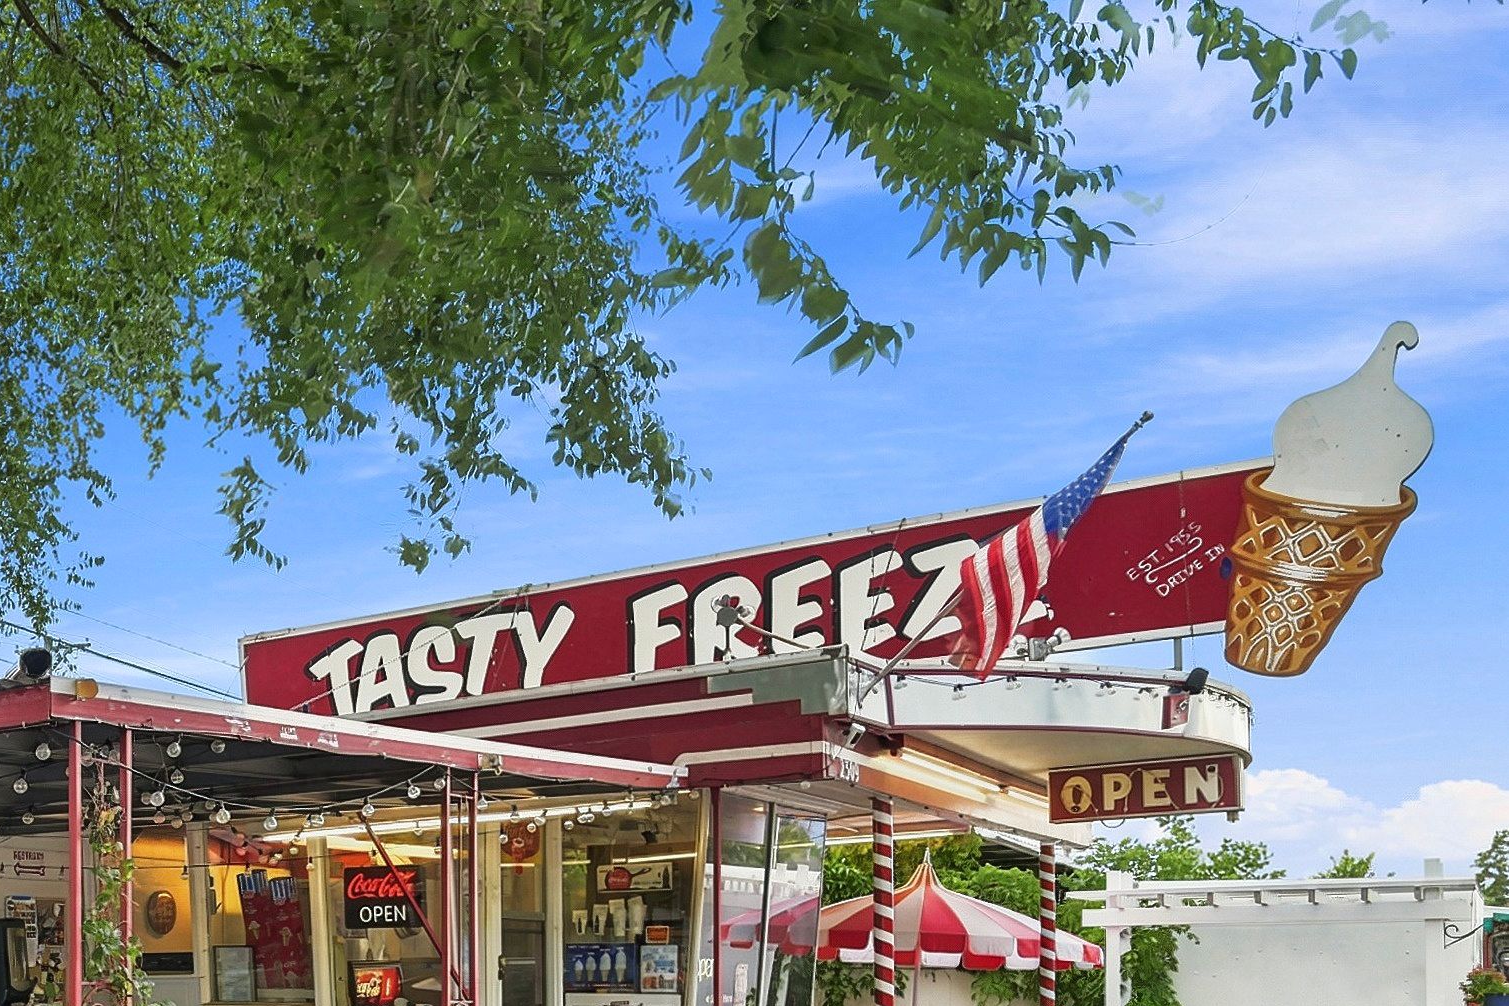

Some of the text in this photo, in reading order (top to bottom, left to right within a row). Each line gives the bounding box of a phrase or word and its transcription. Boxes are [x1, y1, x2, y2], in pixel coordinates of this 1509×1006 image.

[1126, 521, 1202, 581] EST. 1955
[1155, 542, 1226, 597] DRIVE IN
[306, 536, 1048, 717] TASTY FREEZ
[1060, 763, 1220, 815] OPEN
[359, 904, 407, 923] OPEN
